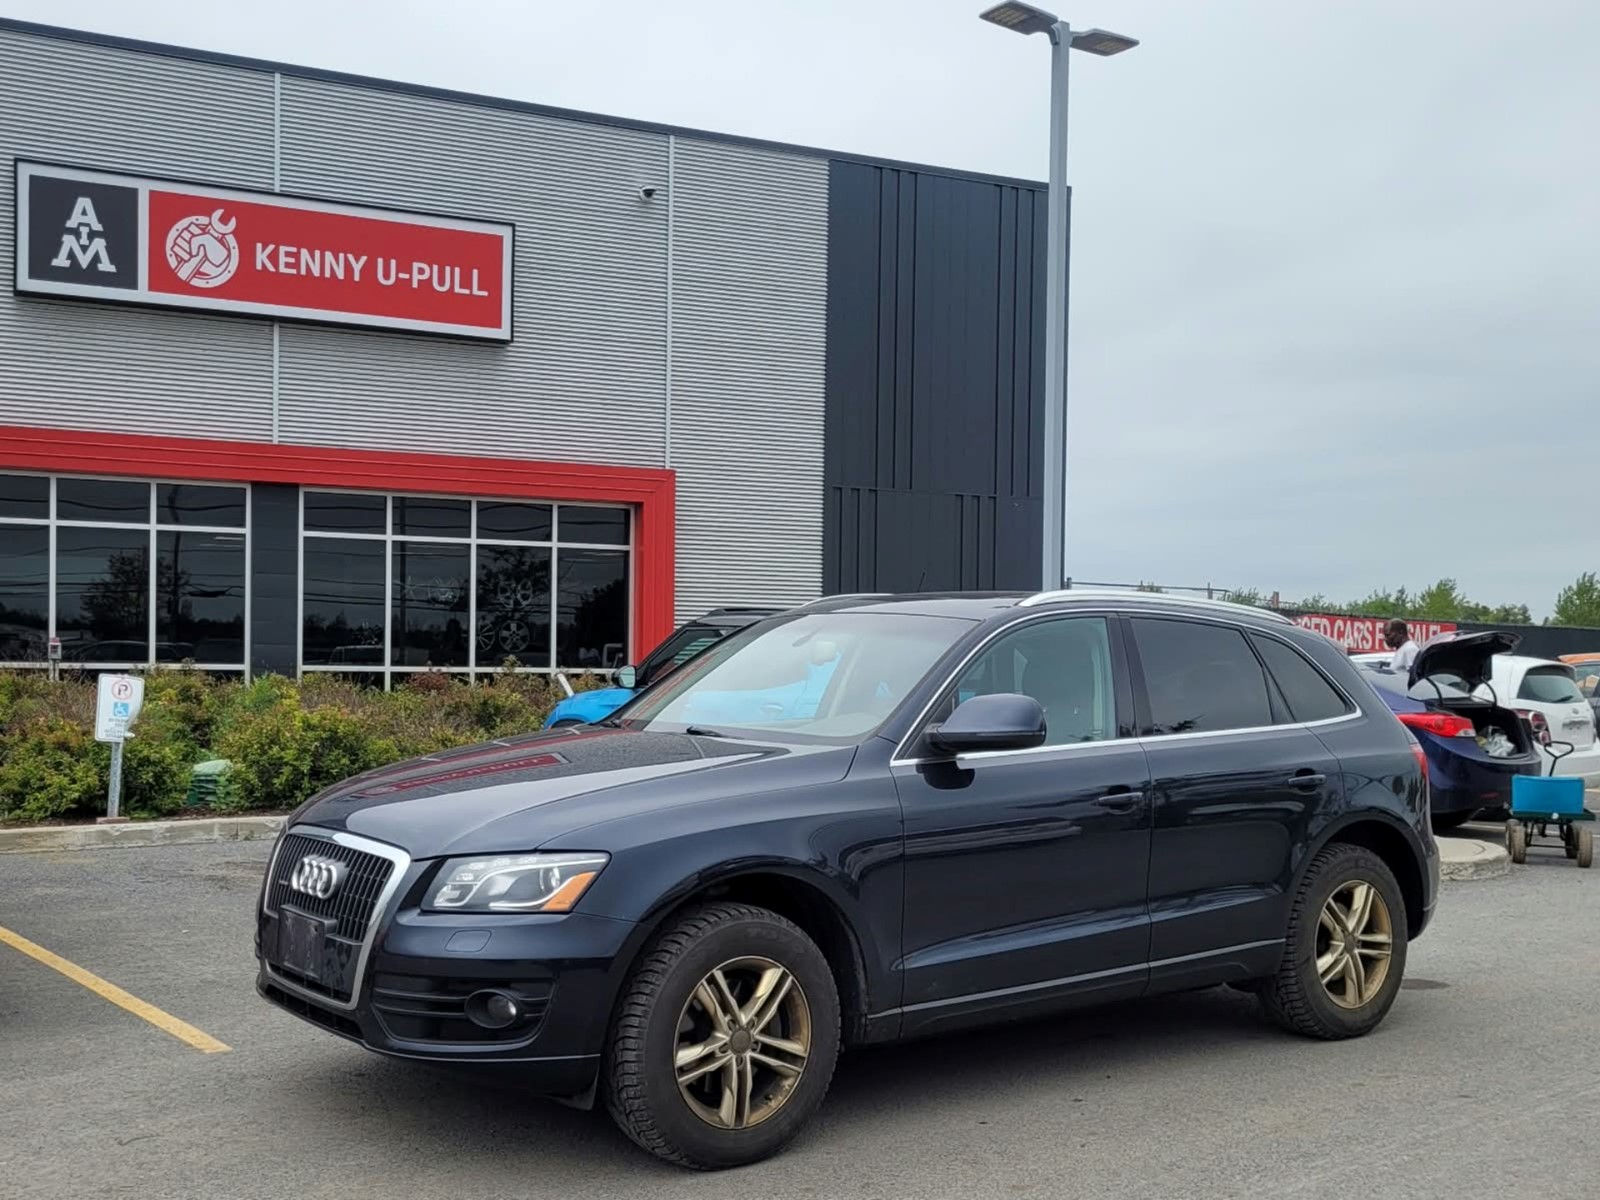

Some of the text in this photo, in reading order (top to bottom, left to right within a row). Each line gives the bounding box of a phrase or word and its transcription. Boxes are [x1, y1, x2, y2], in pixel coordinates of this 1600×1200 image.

[255, 242, 489, 297] KENNY U-PULL
[1333, 619, 1373, 650] CARS
